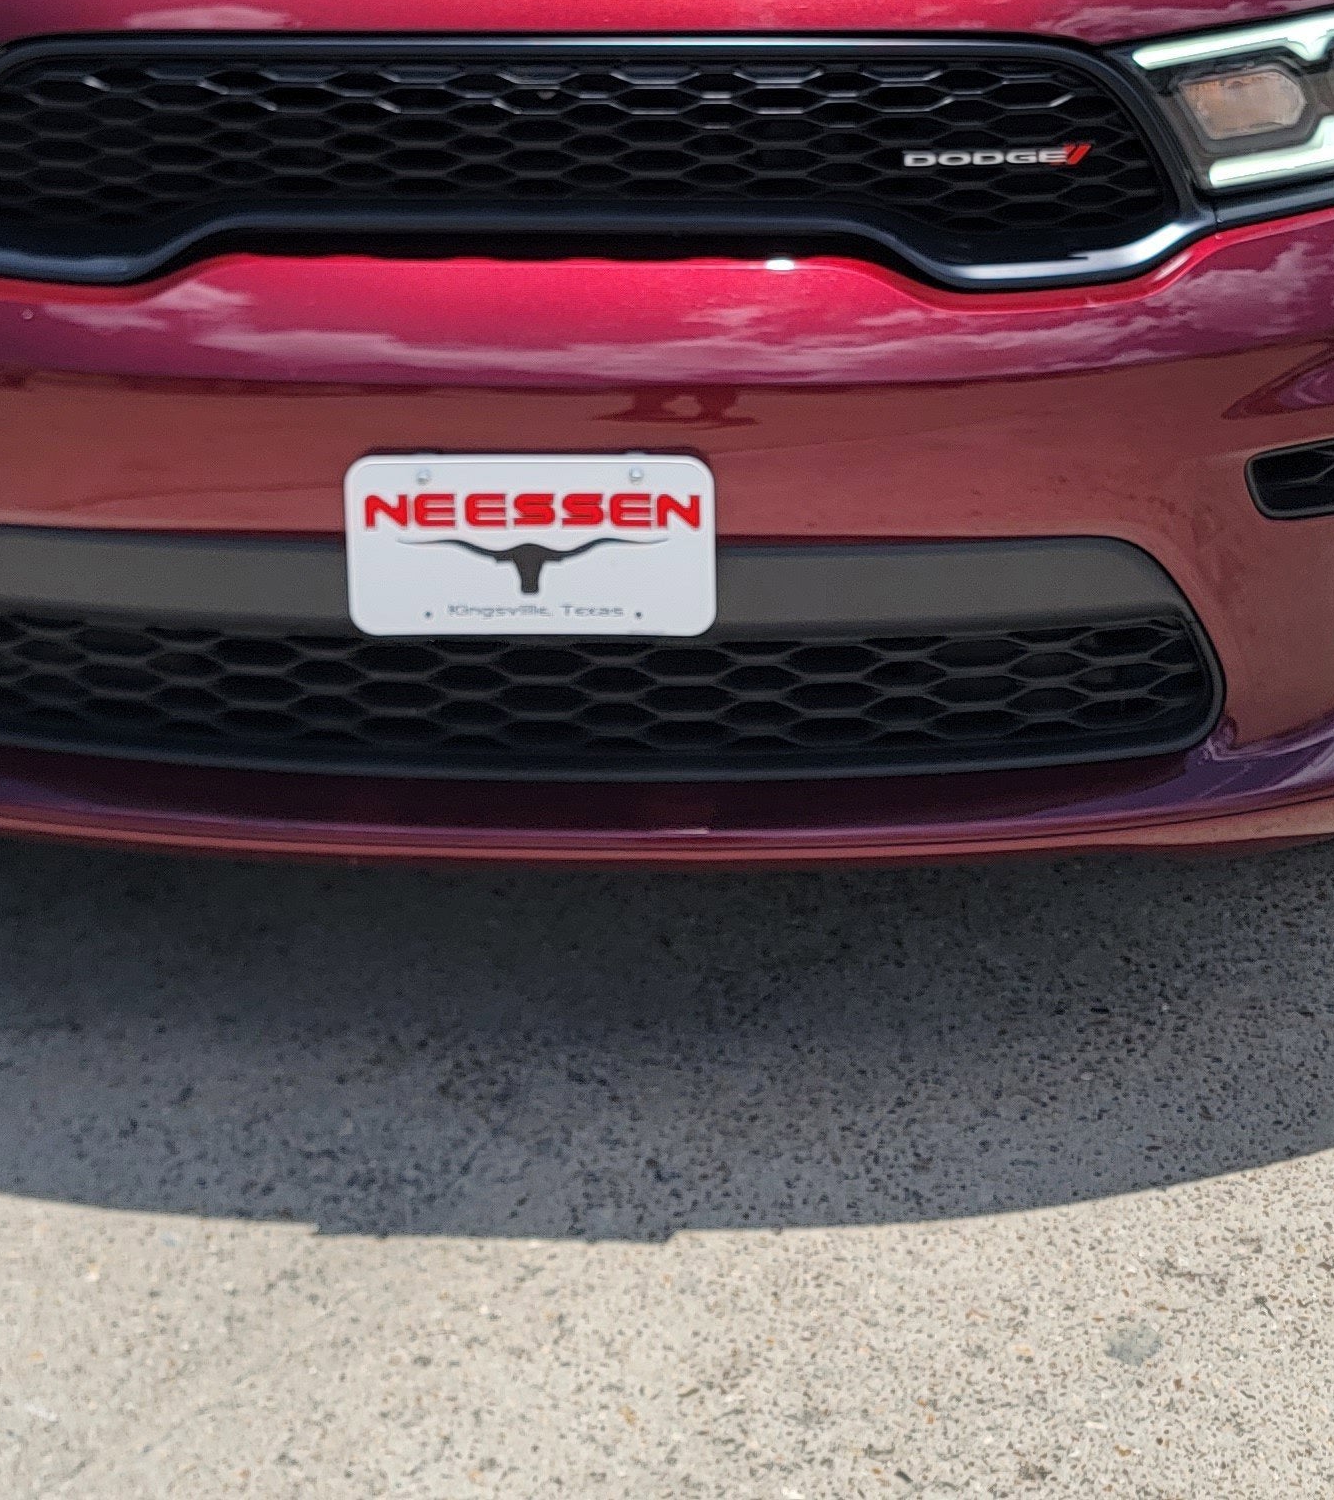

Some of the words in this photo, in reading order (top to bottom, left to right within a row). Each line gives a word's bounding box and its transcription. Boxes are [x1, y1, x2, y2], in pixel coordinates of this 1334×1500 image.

[903, 150, 1068, 167] DODGE
[364, 493, 701, 529] NEESSEN
[559, 605, 624, 617] Texas
